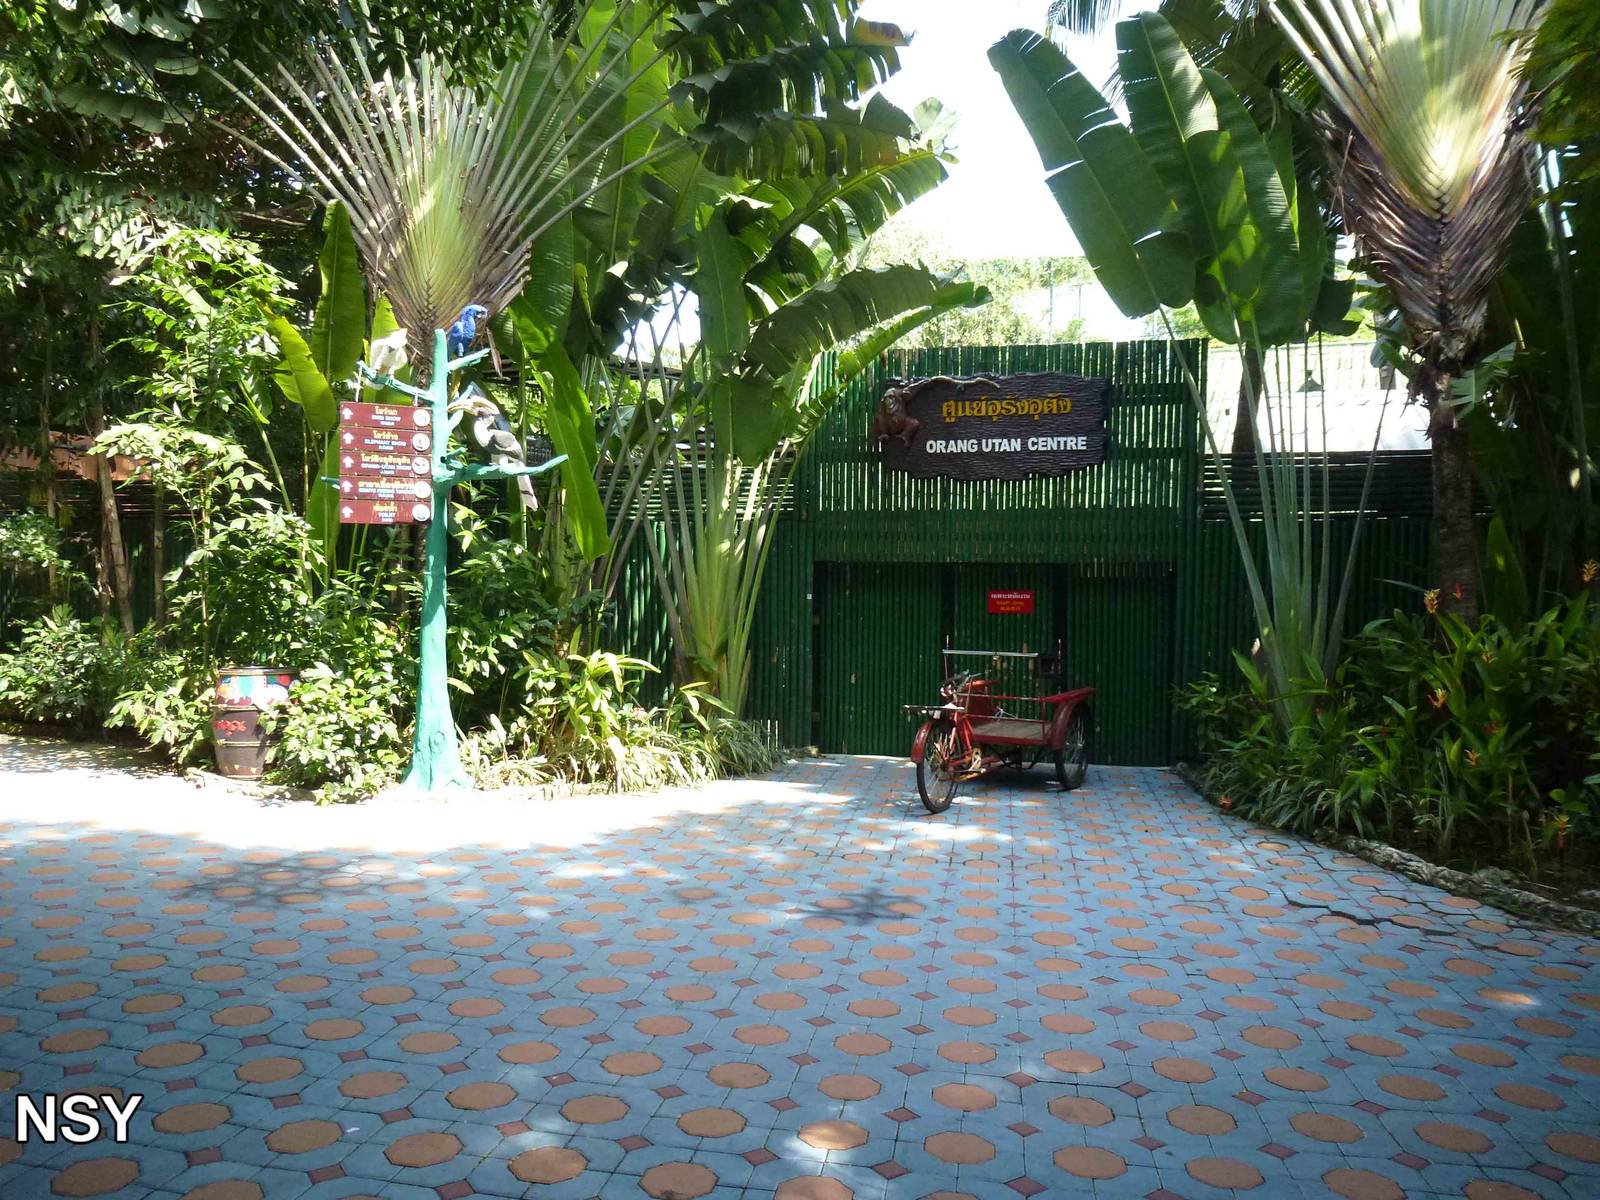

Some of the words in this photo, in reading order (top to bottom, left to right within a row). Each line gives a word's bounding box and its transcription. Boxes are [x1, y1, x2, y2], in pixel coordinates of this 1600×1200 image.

[926, 439, 978, 454] ORANG
[982, 439, 1022, 453] UTAN
[1027, 436, 1088, 451] CENTRE
